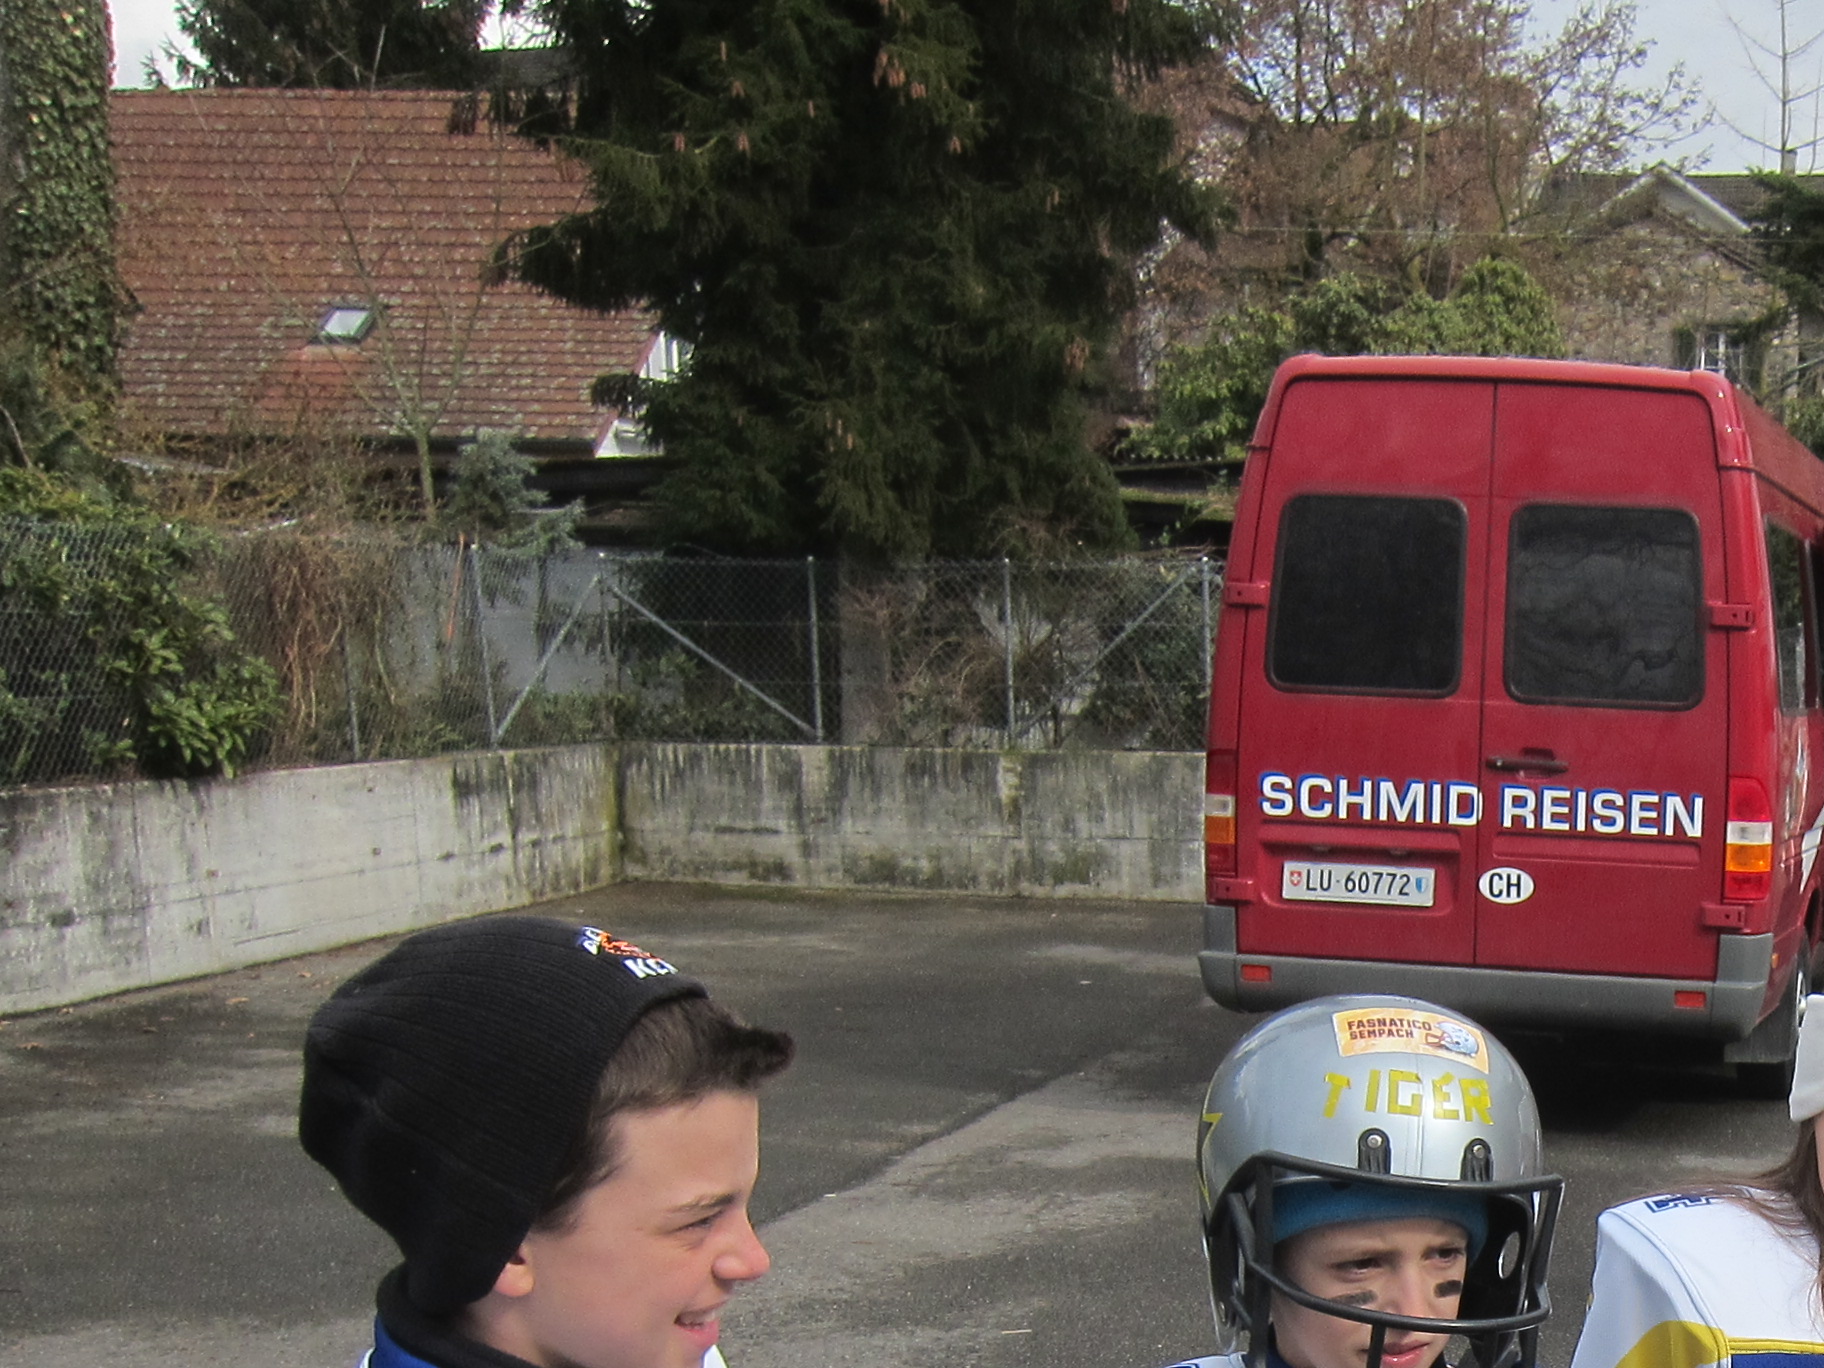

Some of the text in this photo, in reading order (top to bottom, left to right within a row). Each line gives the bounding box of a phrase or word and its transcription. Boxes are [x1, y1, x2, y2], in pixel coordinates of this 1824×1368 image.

[1260, 773, 1704, 839] SCHMID REISEN
[1488, 872, 1524, 900] CH
[1346, 1017, 1433, 1032] FASNATICO
[1349, 1028, 1415, 1041] SEMPACH
[1322, 1068, 1495, 1126] TIGER
